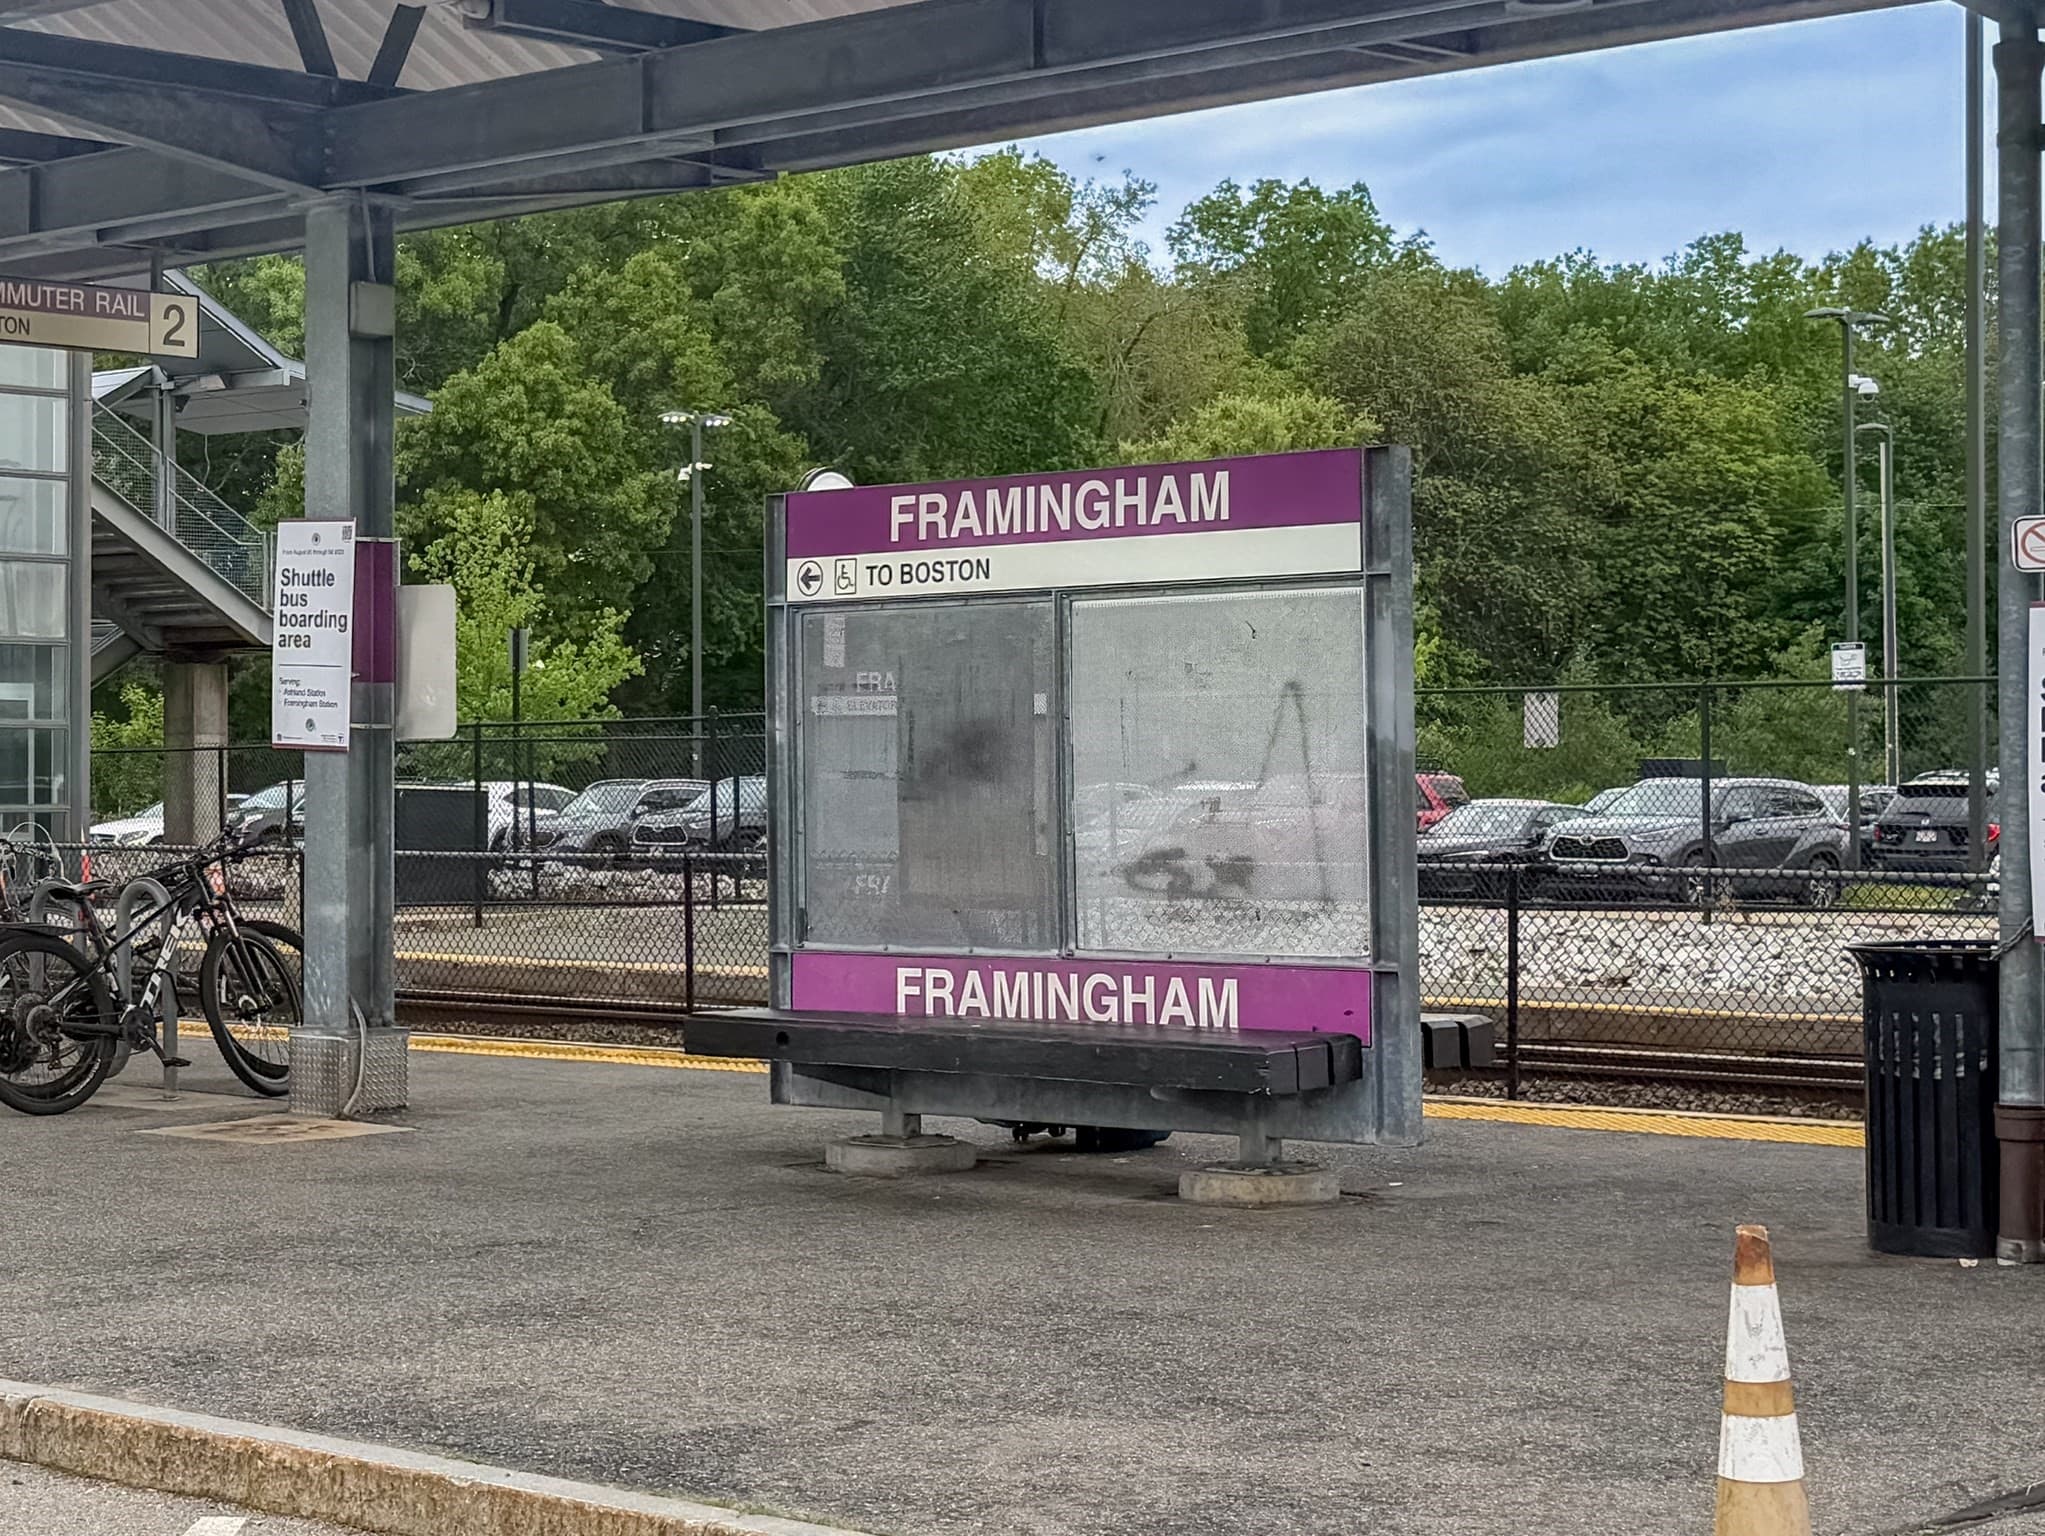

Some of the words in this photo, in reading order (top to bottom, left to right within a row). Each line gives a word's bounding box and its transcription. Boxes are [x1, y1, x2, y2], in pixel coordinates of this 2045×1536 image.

[96, 291, 145, 317] RAIL
[162, 304, 185, 347] 2
[890, 471, 1230, 543] FRAMINGHAM
[281, 568, 335, 587] Shuttle
[865, 564, 893, 586] TO
[900, 558, 990, 585] BOSTON
[280, 588, 308, 607] bus
[279, 609, 347, 633] boarding
[278, 633, 311, 648] area
[896, 967, 1239, 1029] FRAMINGHAM
